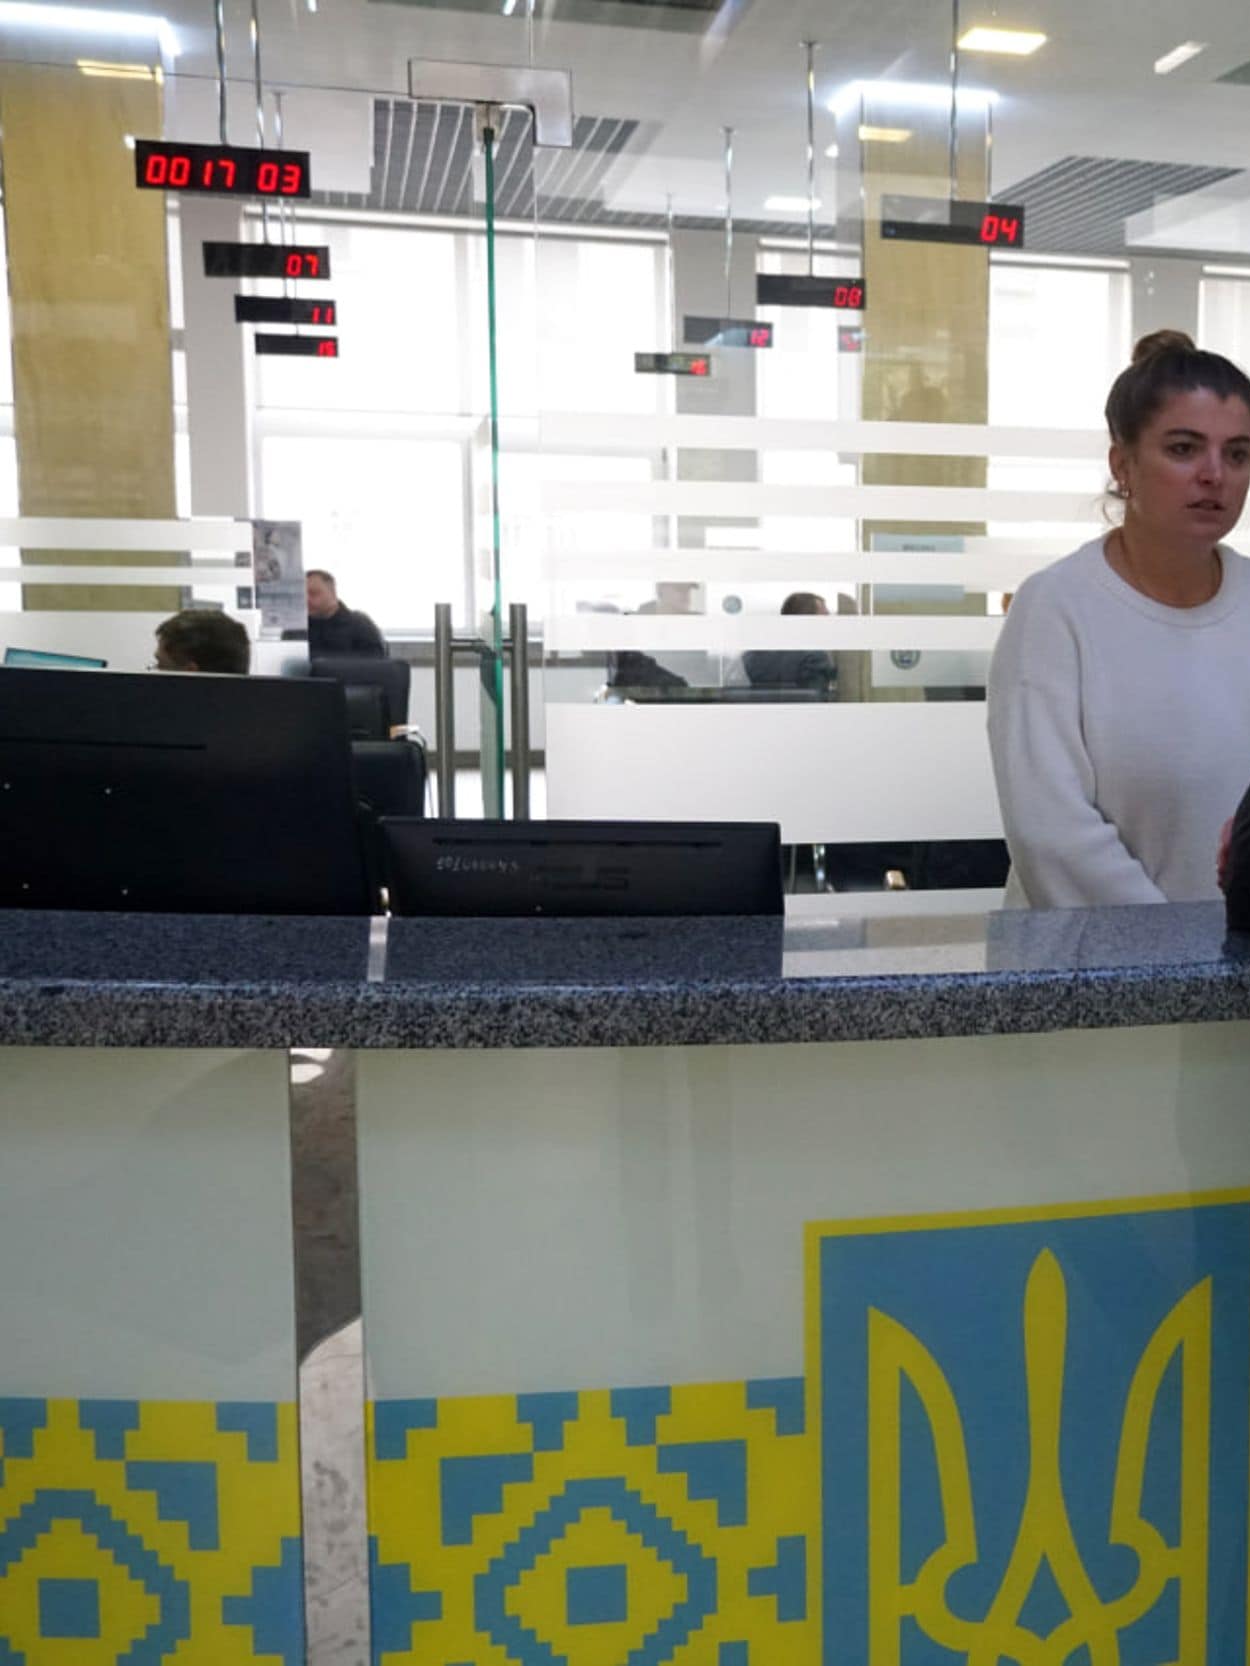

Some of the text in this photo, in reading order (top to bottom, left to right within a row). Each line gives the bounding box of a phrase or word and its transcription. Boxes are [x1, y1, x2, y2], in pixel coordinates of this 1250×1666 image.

[257, 163, 302, 194] 03
[980, 214, 1019, 243] 04
[286, 254, 319, 278] 07
[833, 287, 862, 308] 08
